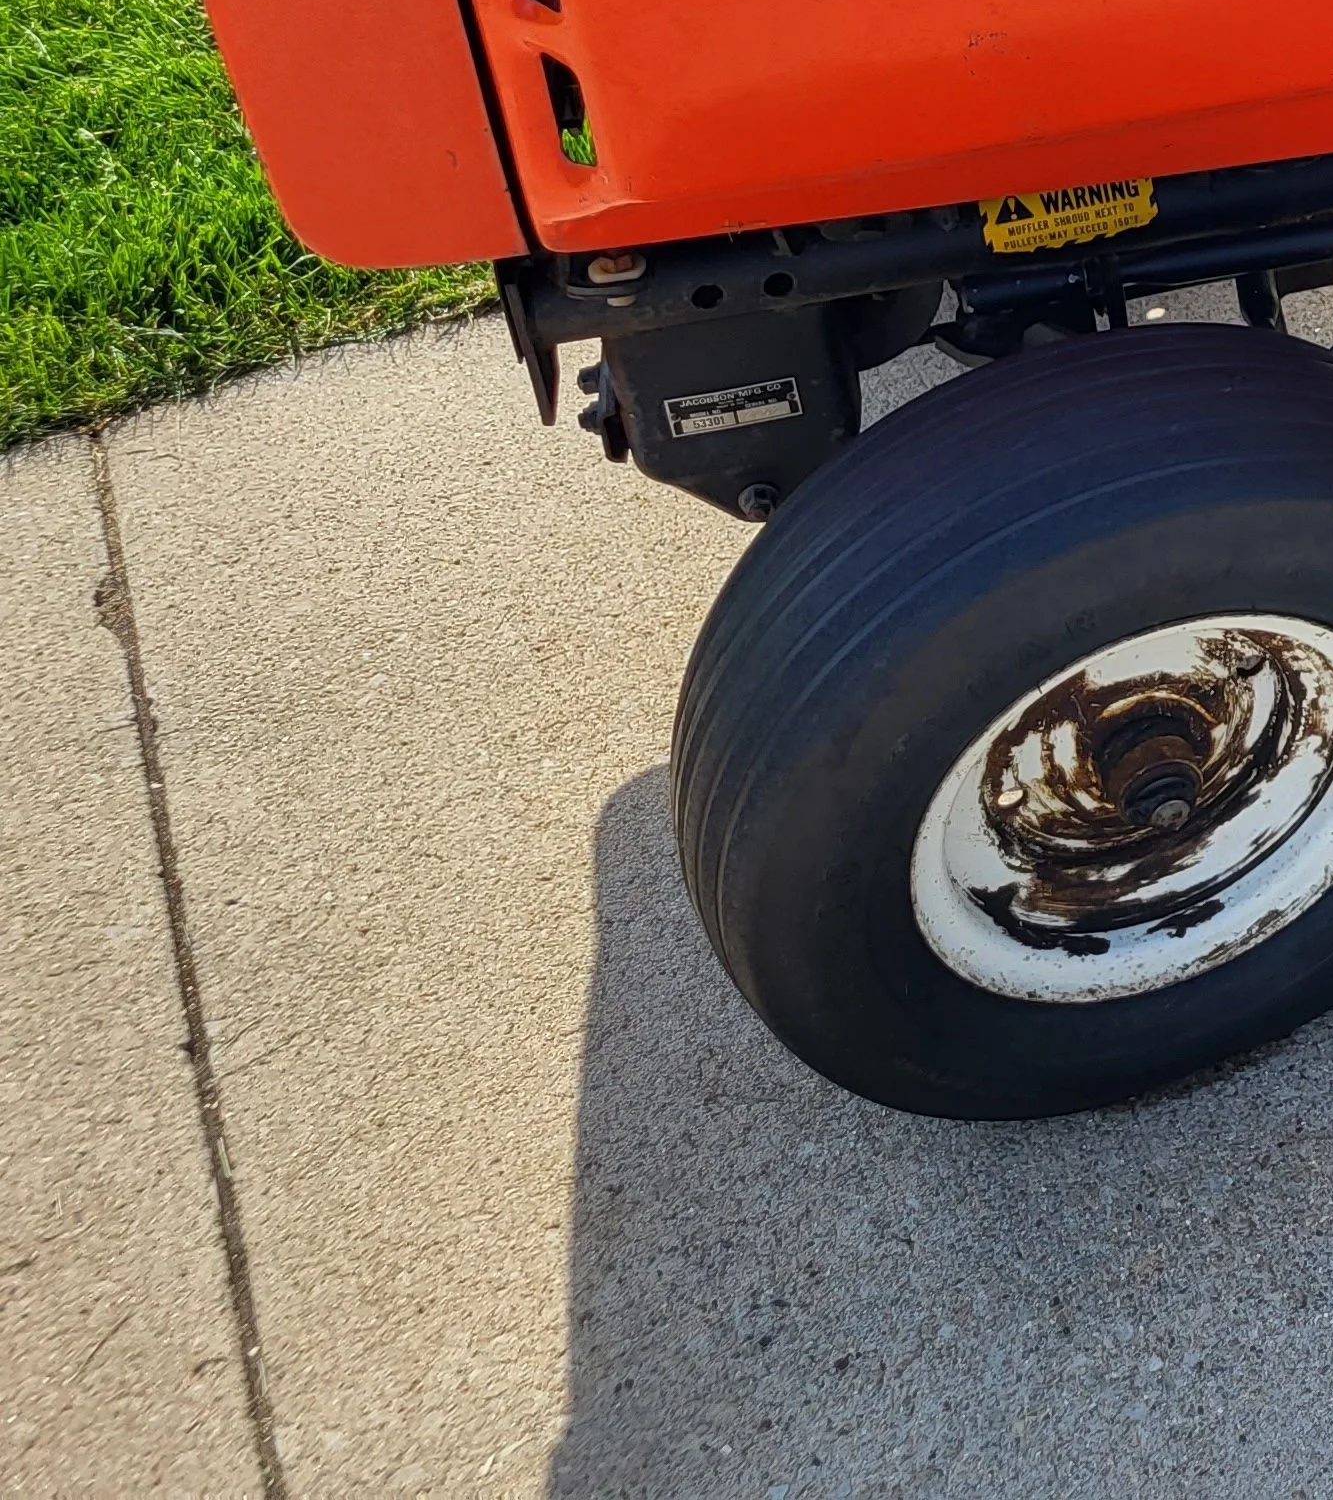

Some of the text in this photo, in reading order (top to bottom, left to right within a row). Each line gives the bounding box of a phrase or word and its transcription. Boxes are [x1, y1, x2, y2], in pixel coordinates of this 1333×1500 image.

[1039, 180, 1140, 215] WARNING
[1007, 202, 1135, 237] MUFFLER SHROUD NEXT TO
[1073, 221, 1109, 236] EXCEED
[693, 416, 725, 429] 53301
